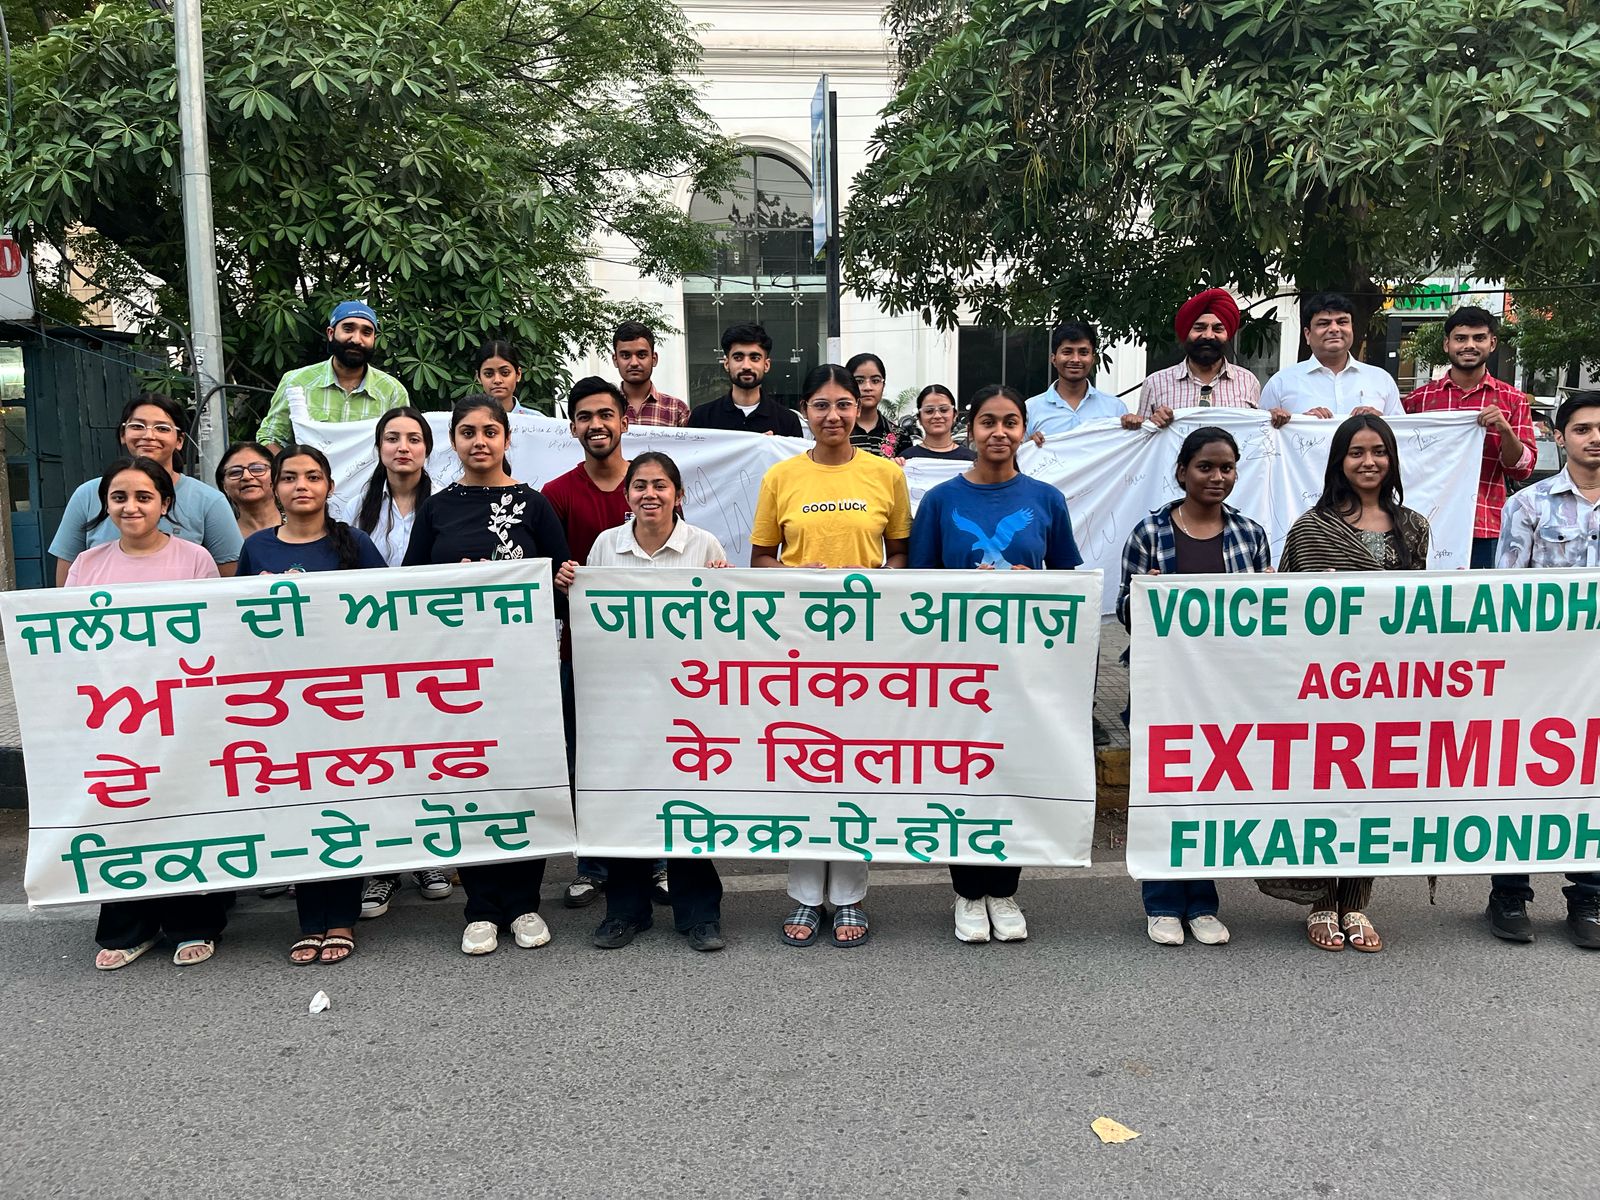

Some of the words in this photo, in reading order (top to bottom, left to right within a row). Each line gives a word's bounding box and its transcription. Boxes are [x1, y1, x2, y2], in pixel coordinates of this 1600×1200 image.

[802, 503, 836, 513] GOOD
[838, 502, 867, 512] LUCK
[15, 590, 208, 655] ਜਲੰਧਰ
[236, 581, 311, 639] ਦੀ
[339, 582, 540, 631] ਆਵਾਜ਼
[585, 576, 785, 641] जालंधर
[799, 573, 881, 641] की
[900, 591, 1086, 649] आवाज़
[1147, 587, 1289, 637] VOICE
[1304, 586, 1365, 636] OF
[1379, 581, 1600, 635] JALANDH
[77, 655, 498, 737] ਅੱਤਵਾਦ
[671, 649, 999, 713] आतंकवाद
[1297, 660, 1506, 700] AGAINST
[83, 753, 161, 809] ਦੇ
[209, 739, 498, 797] ਖ਼ਿਲਾਫ਼
[665, 718, 741, 781] के
[757, 721, 1004, 785] खिलाफ
[655, 799, 1013, 863] फ़िक्र-ऐ-होंद
